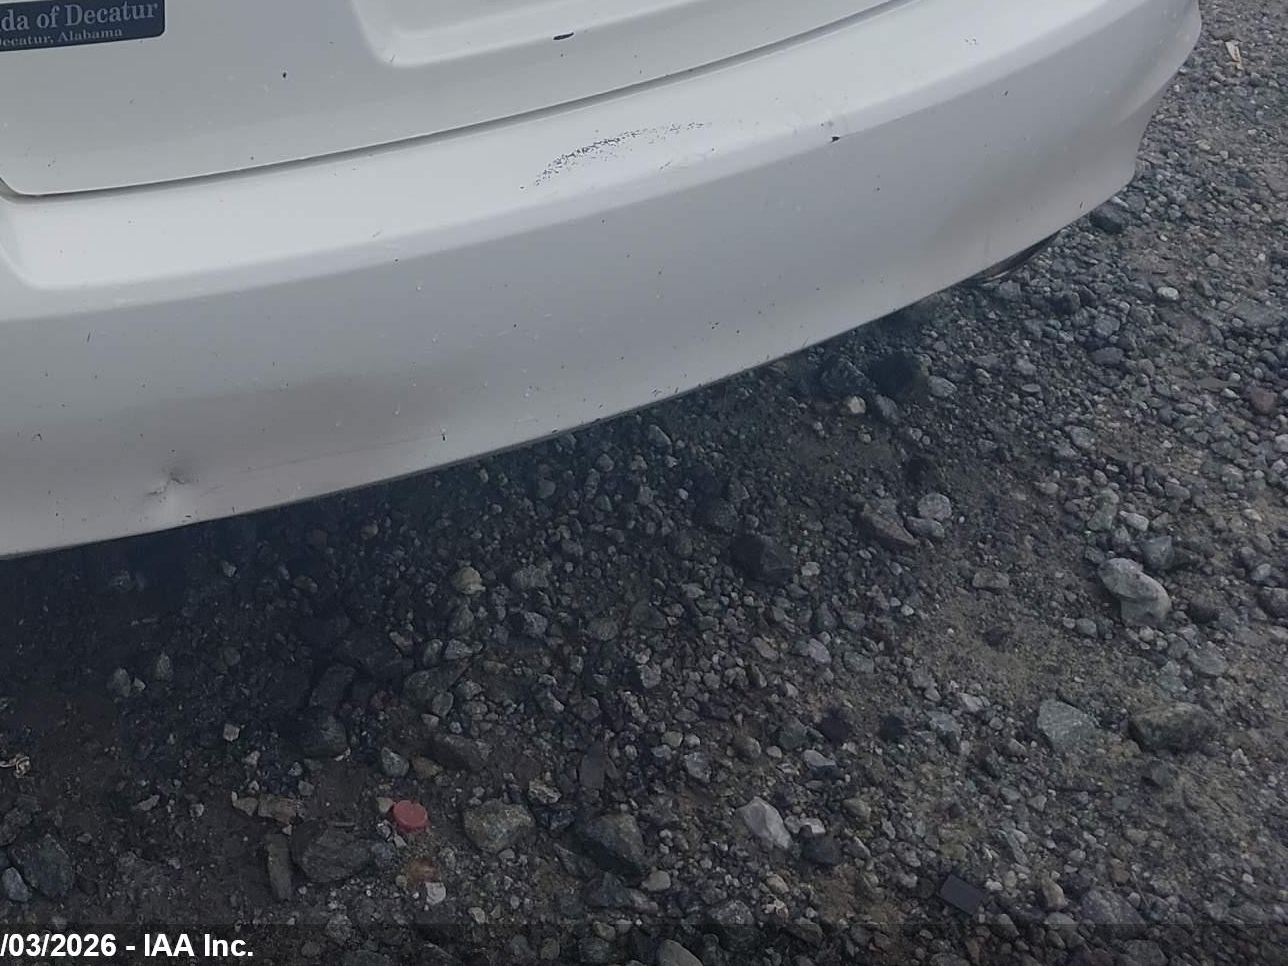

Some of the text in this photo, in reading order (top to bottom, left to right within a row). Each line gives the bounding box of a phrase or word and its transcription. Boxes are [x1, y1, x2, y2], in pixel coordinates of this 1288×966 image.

[36, 5, 60, 29] of
[64, 2, 159, 26] Decatur
[58, 29, 123, 43] Alabama
